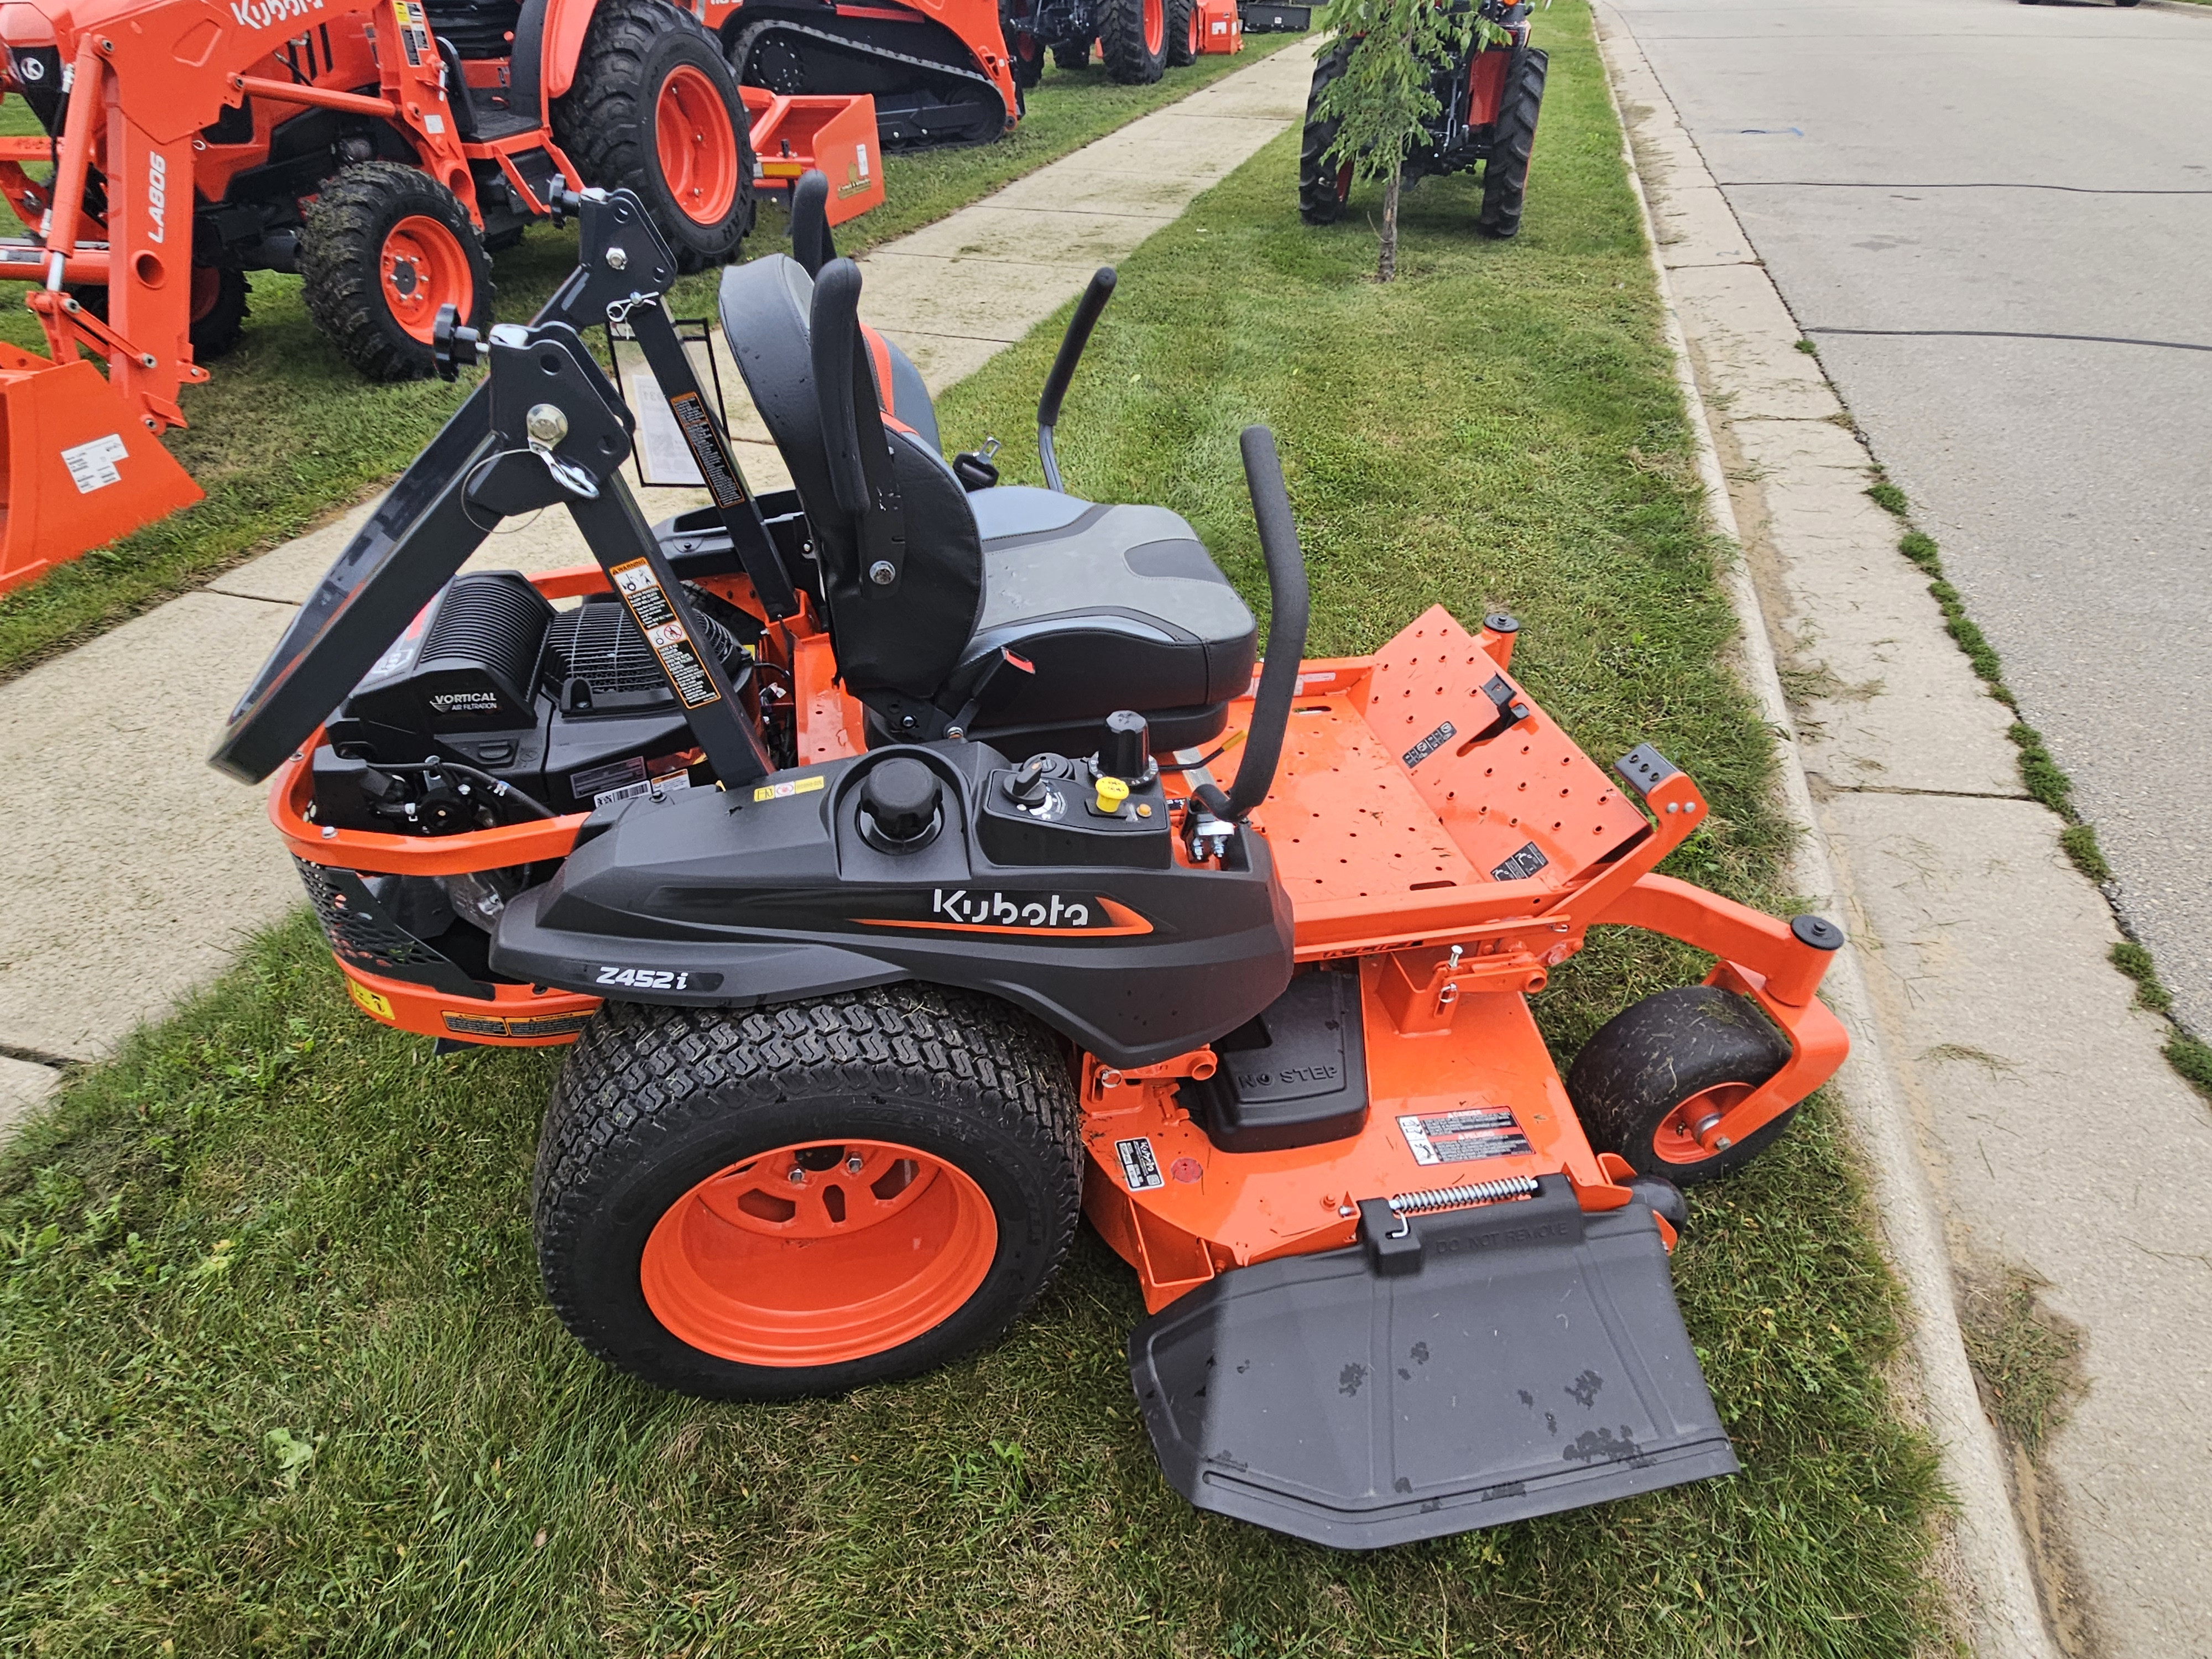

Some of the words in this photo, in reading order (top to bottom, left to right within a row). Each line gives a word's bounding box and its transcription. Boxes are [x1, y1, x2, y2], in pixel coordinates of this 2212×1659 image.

[148, 150, 166, 243] LA806
[435, 692, 497, 704] VORTICAL
[933, 889, 1088, 926] Kubota
[1238, 1073, 1272, 1089] NO
[1280, 1065, 1338, 1084] STEP
[1437, 1239, 1459, 1254] DO
[1505, 1223, 1568, 1243] REMOVE
